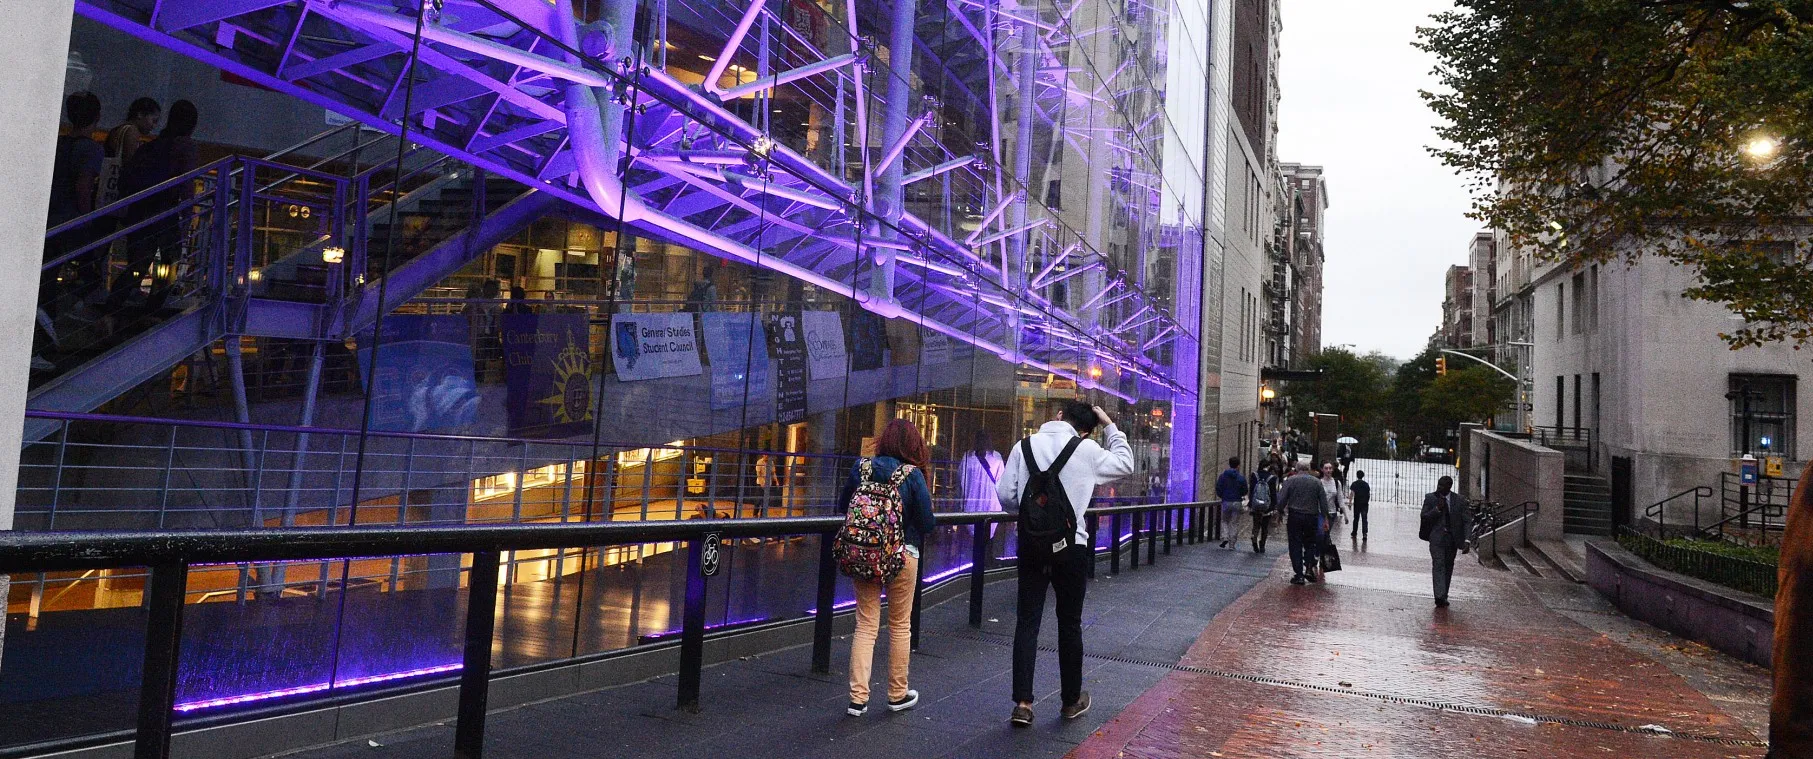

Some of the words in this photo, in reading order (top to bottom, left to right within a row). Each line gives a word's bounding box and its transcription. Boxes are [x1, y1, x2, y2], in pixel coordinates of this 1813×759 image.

[506, 328, 559, 347] Canterbury
[641, 327, 666, 338] General
[667, 326, 691, 337] Studies
[643, 342, 668, 354] Student
[669, 341, 694, 353] Council
[509, 350, 533, 366] Club
